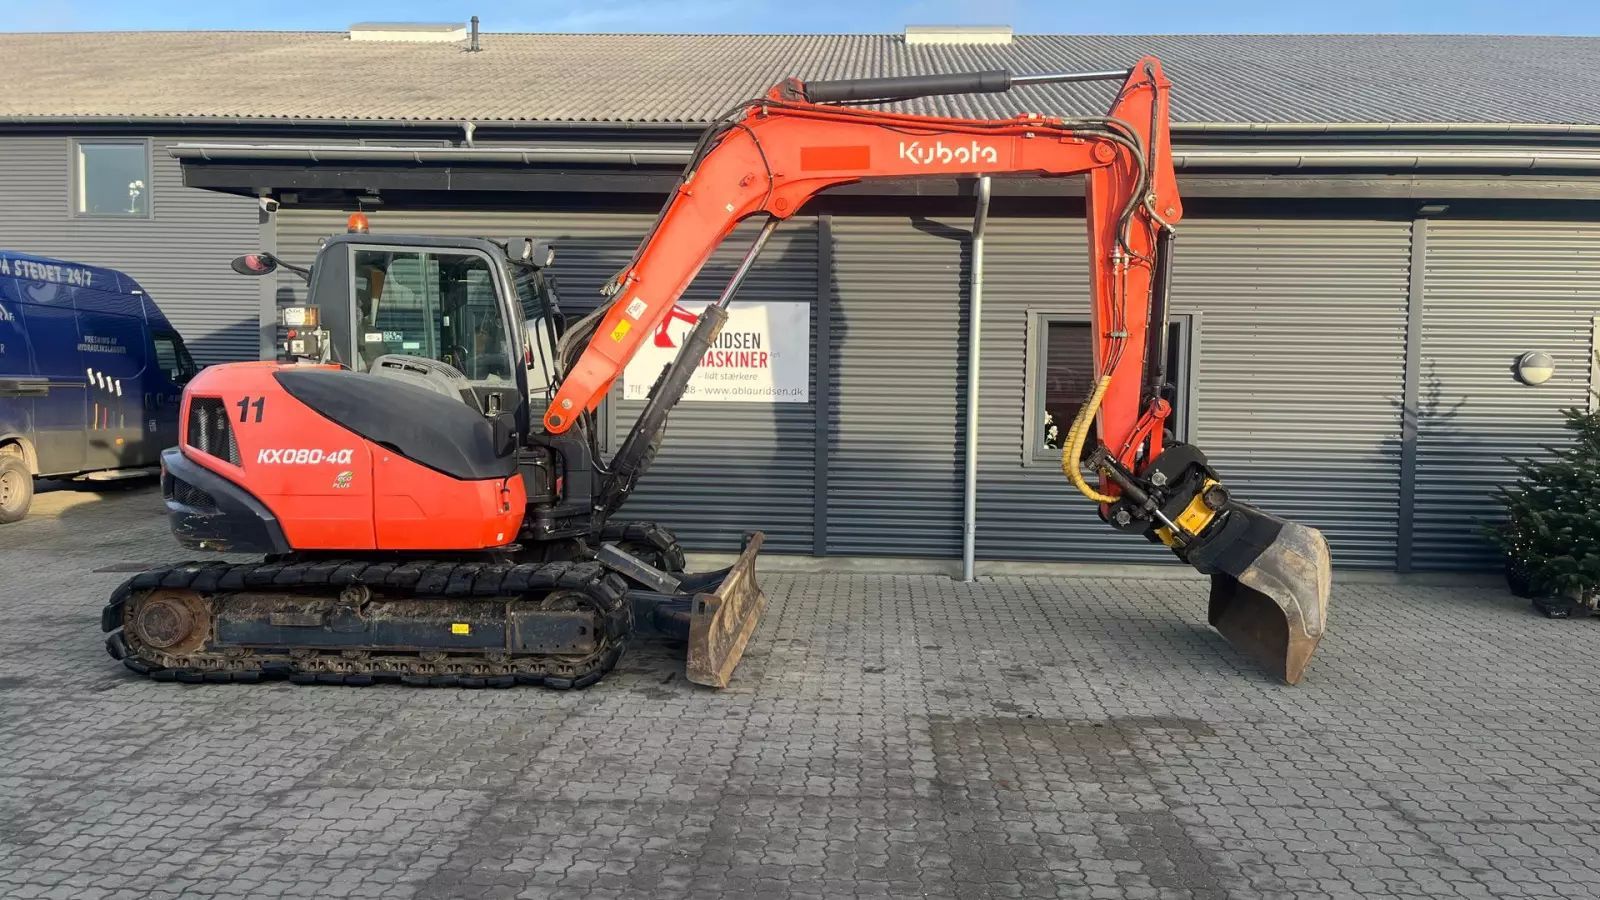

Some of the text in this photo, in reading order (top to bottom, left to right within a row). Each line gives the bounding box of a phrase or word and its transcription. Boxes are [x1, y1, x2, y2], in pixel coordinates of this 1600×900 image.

[899, 141, 997, 164] Kubota
[14, 260, 61, 282] STEDET
[66, 268, 92, 287] 24/7
[704, 387, 804, 396] www.ablauridsen.dk
[237, 396, 265, 423] 11
